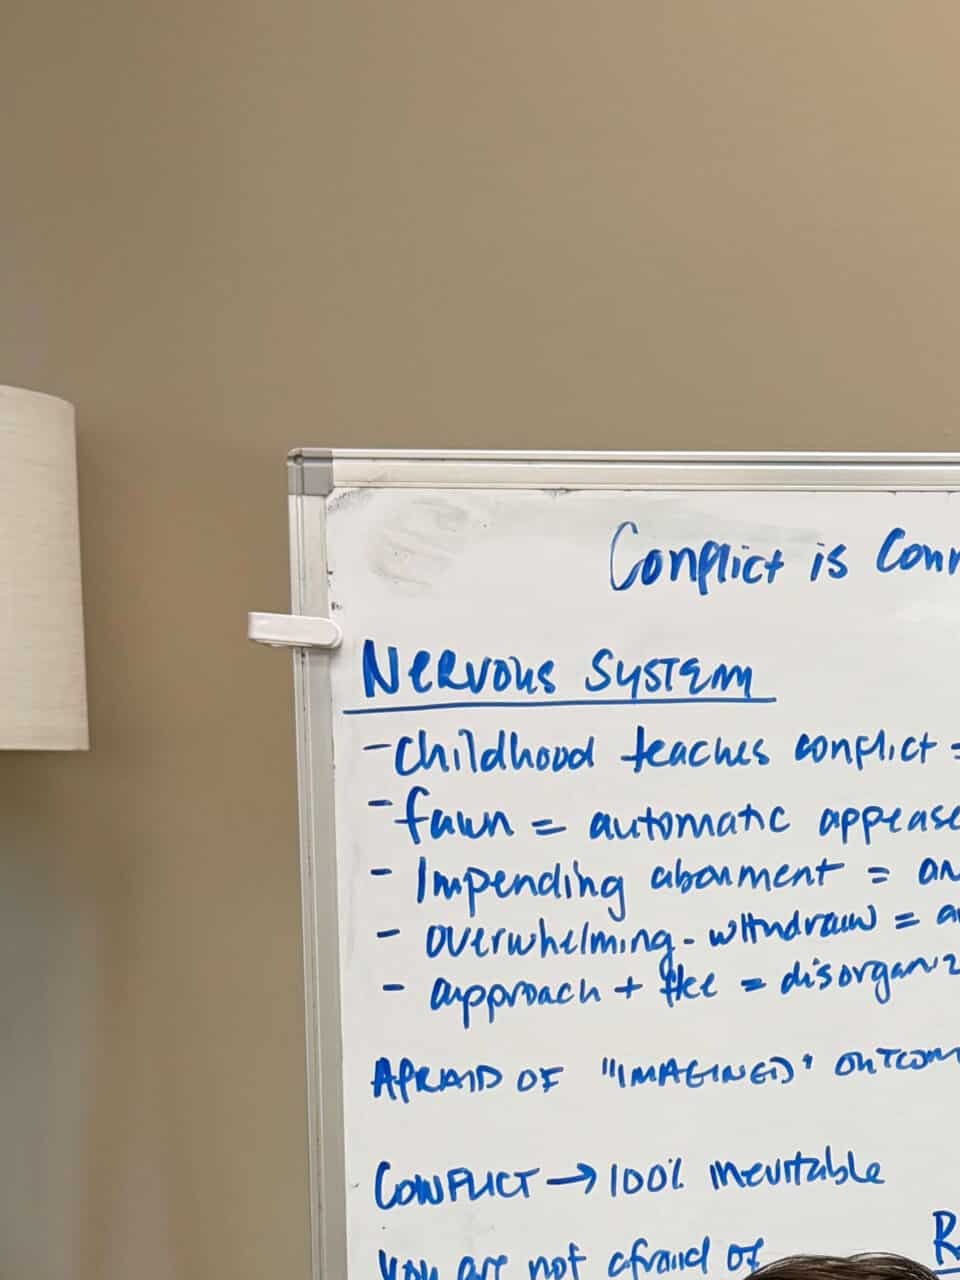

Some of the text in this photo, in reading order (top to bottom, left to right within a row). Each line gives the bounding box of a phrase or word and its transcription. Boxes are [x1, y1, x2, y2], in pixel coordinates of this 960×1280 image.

[610, 523, 785, 597] Conflict
[809, 543, 849, 582] is
[620, 725, 769, 774] teaches
[794, 729, 937, 770] conflict
[589, 803, 790, 841] automatic
[416, 856, 625, 923] Impending
[425, 917, 673, 979] overwhelming
[429, 976, 601, 1030] approach
[516, 1067, 562, 1094] OF
